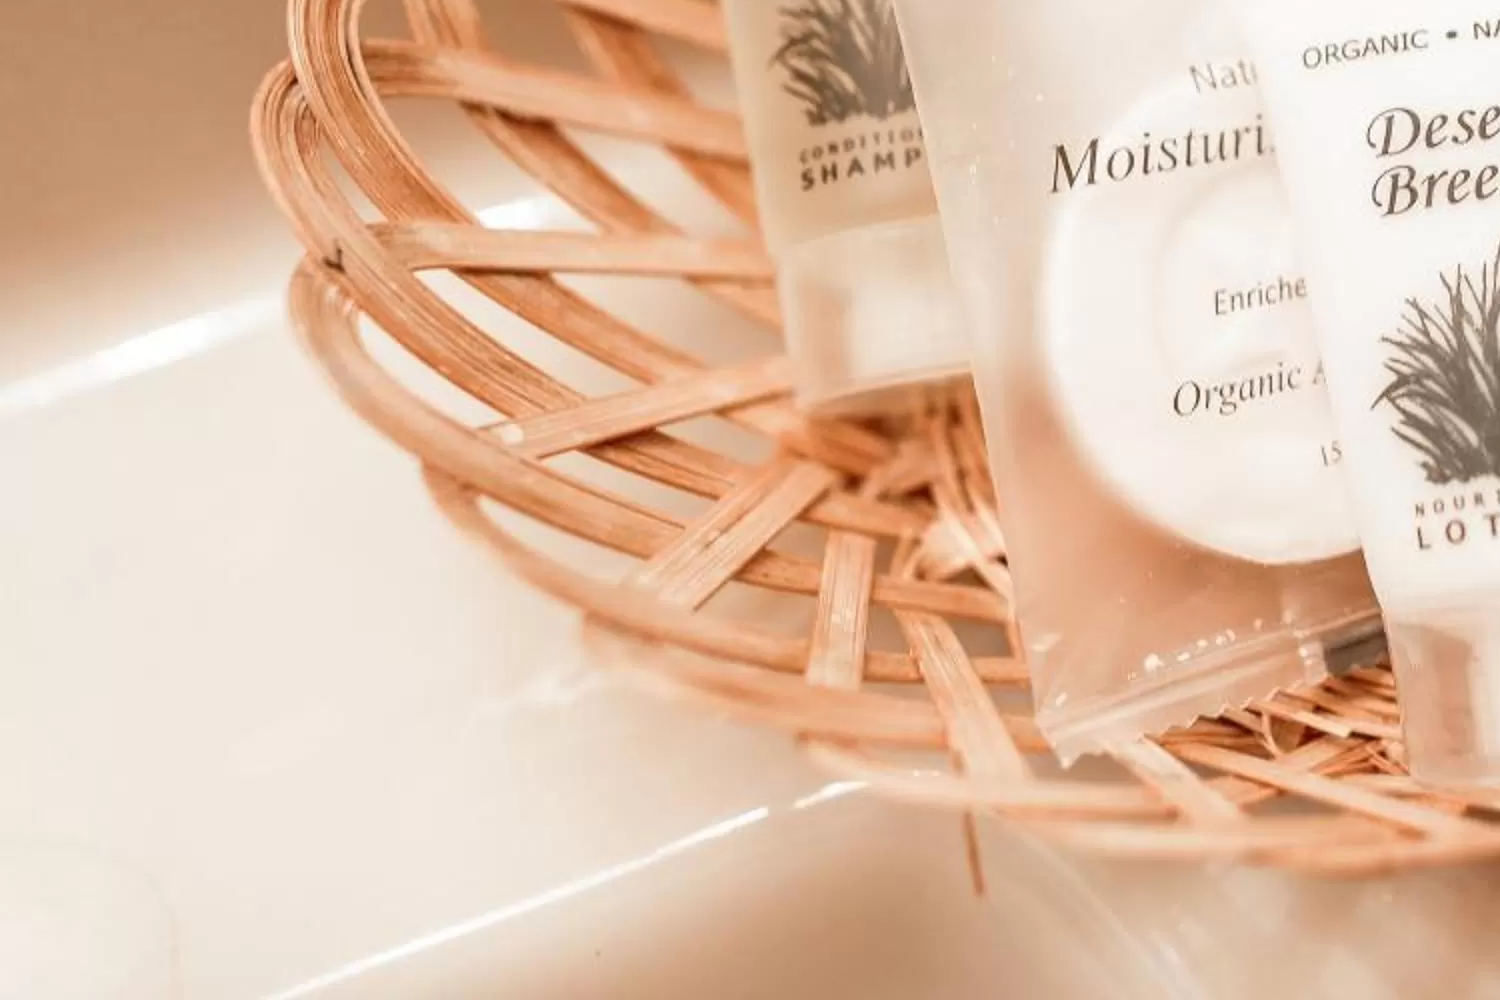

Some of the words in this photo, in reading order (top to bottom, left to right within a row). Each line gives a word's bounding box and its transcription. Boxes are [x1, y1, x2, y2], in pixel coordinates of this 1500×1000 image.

[1302, 29, 1429, 70] ORGANIC
[799, 128, 924, 165] CONDITIO
[1050, 112, 1276, 194] Moisturi
[800, 146, 923, 192] SHAMP
[1213, 275, 1309, 317] Enriche
[1172, 360, 1303, 418] Organic
